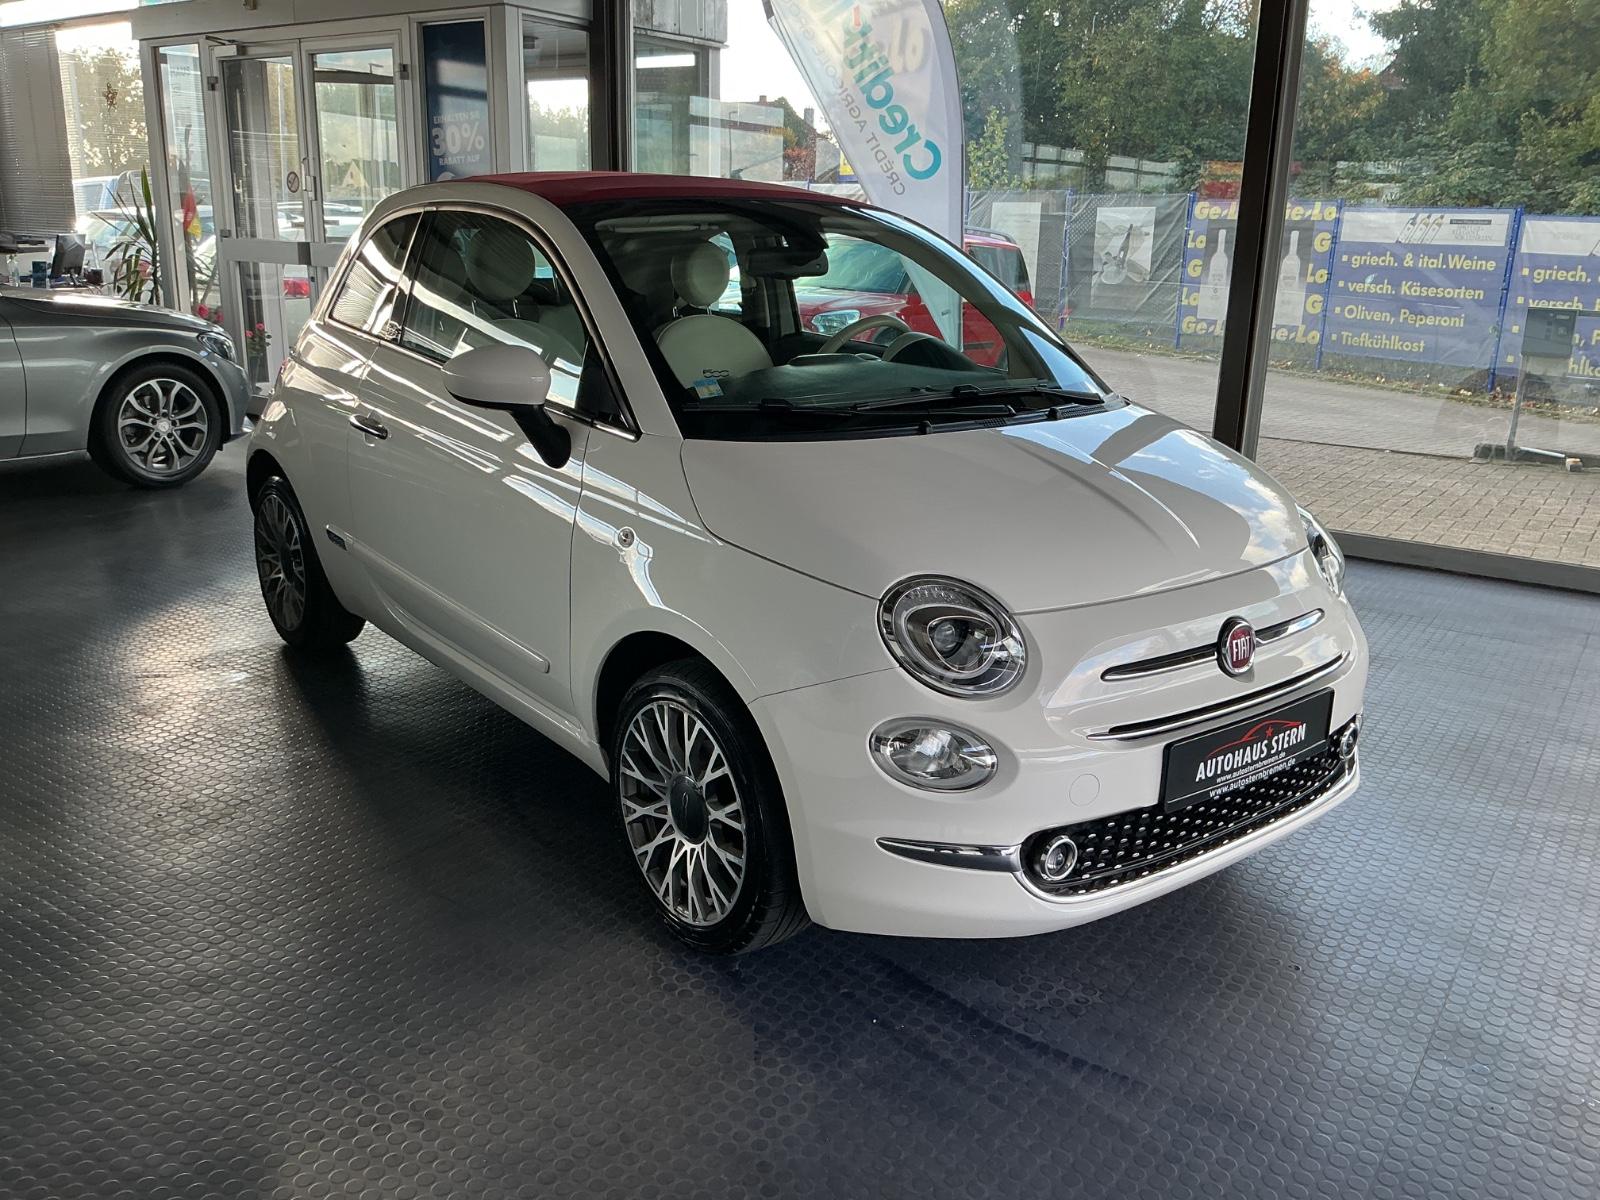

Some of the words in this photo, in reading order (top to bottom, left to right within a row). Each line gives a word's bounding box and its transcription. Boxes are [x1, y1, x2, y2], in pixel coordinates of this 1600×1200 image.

[432, 121, 485, 156] 30%
[1187, 229, 1207, 249] Lo
[1314, 231, 1332, 253] G
[1187, 258, 1203, 277] G
[1351, 251, 1398, 268] griech.
[1403, 253, 1414, 267] &
[1306, 263, 1329, 285] Lo
[1533, 265, 1591, 283] griech.
[1347, 279, 1396, 295] versch.
[1401, 280, 1484, 300] Käsesorten
[1305, 293, 1323, 314] G
[1344, 305, 1395, 325] Oliven,
[1400, 309, 1465, 328] Peperoni
[1341, 331, 1425, 352] Tiefkühlkost
[1232, 635, 1251, 662] FIAT
[1196, 740, 1268, 781] AUTOHAUS
[1271, 723, 1306, 754] STERN
[1209, 758, 1296, 797] www.autosternbremen.de
